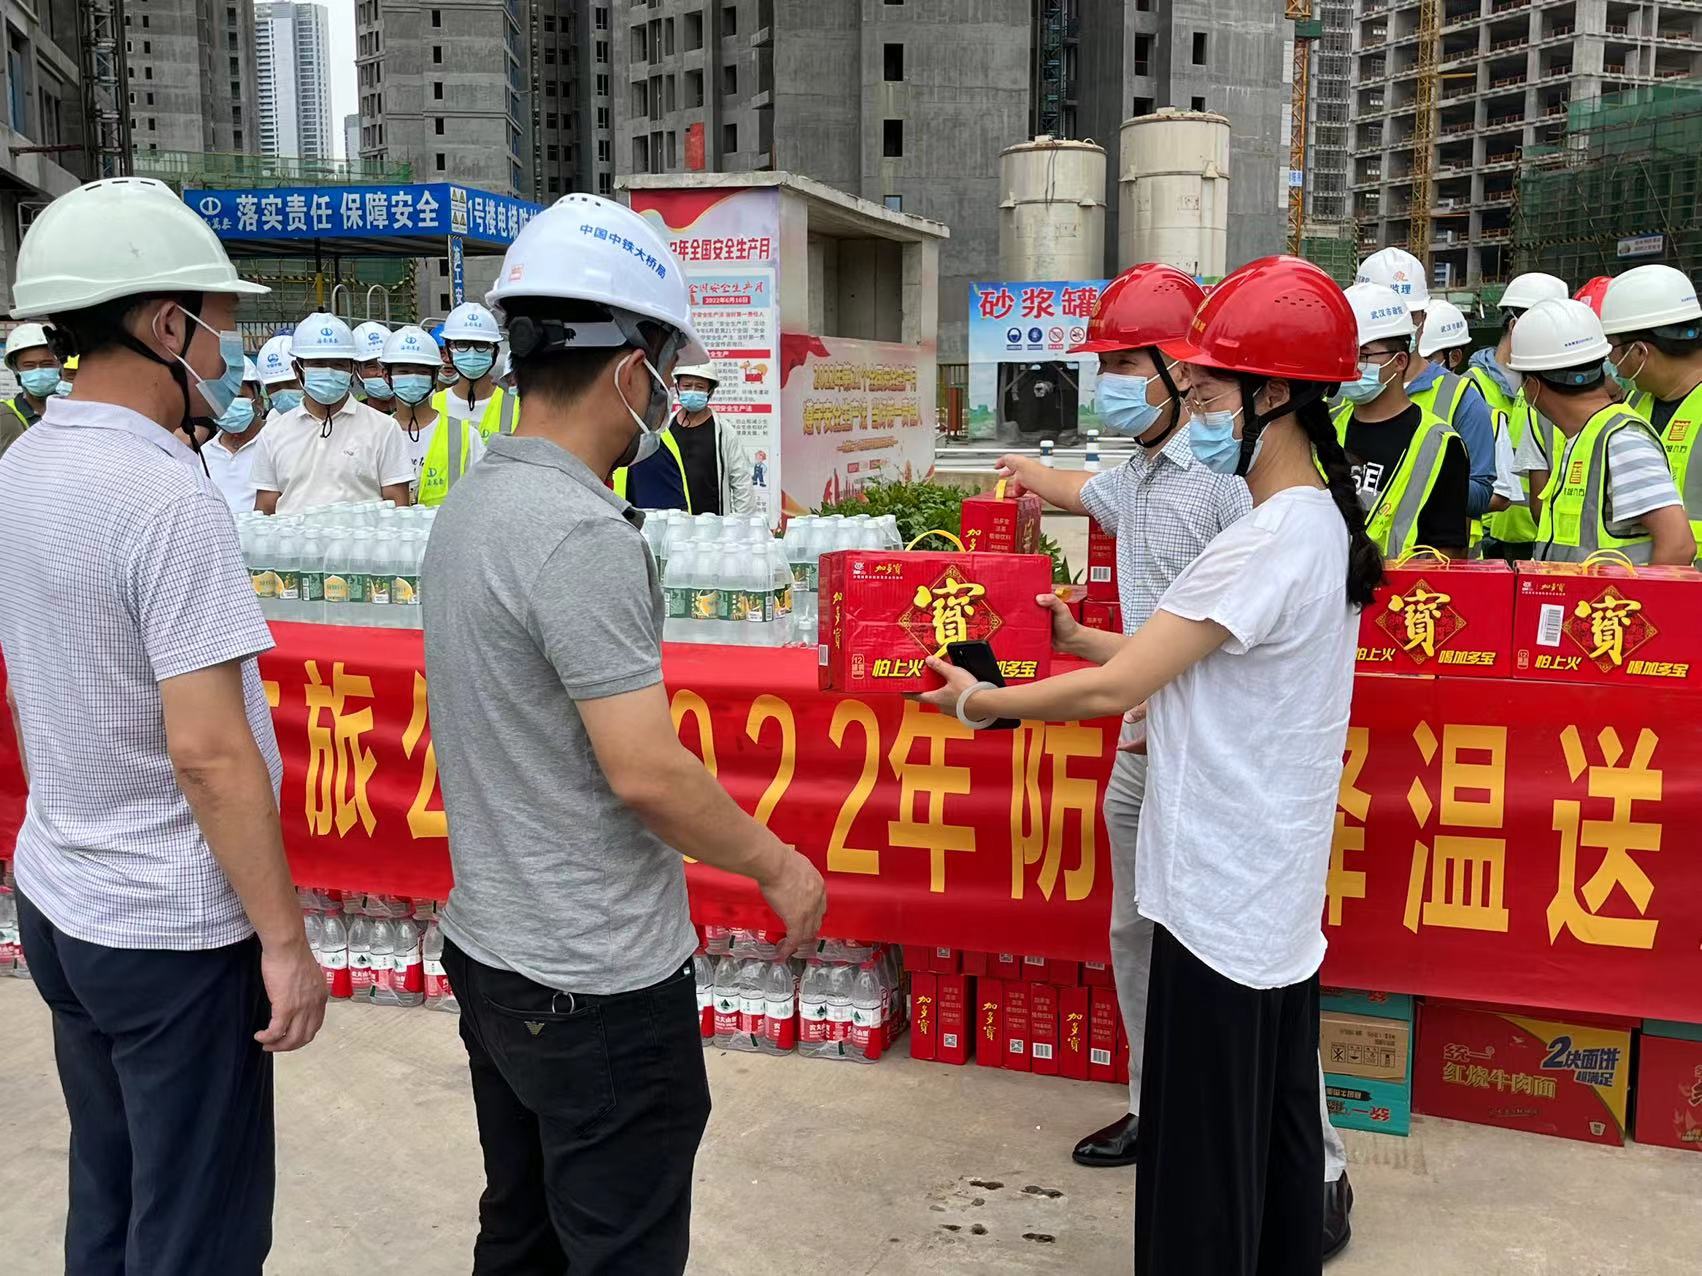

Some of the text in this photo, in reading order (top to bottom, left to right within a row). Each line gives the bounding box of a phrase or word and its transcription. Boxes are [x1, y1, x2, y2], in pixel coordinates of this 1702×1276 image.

[236, 193, 332, 231] 落实责任
[340, 190, 439, 230] 保障安全
[579, 224, 667, 279] 中国中铁大桥局
[979, 287, 1098, 319] 砂浆罐
[872, 659, 924, 678] 怕上火
[1438, 650, 1497, 666] 喝加多宝
[1535, 655, 1690, 678] 怕上火 喝加多宝
[1540, 1035, 1620, 1071] 2块面饼
[1443, 1062, 1556, 1098] 红烧牛肉面
[1574, 1071, 1614, 1087] 超满足
